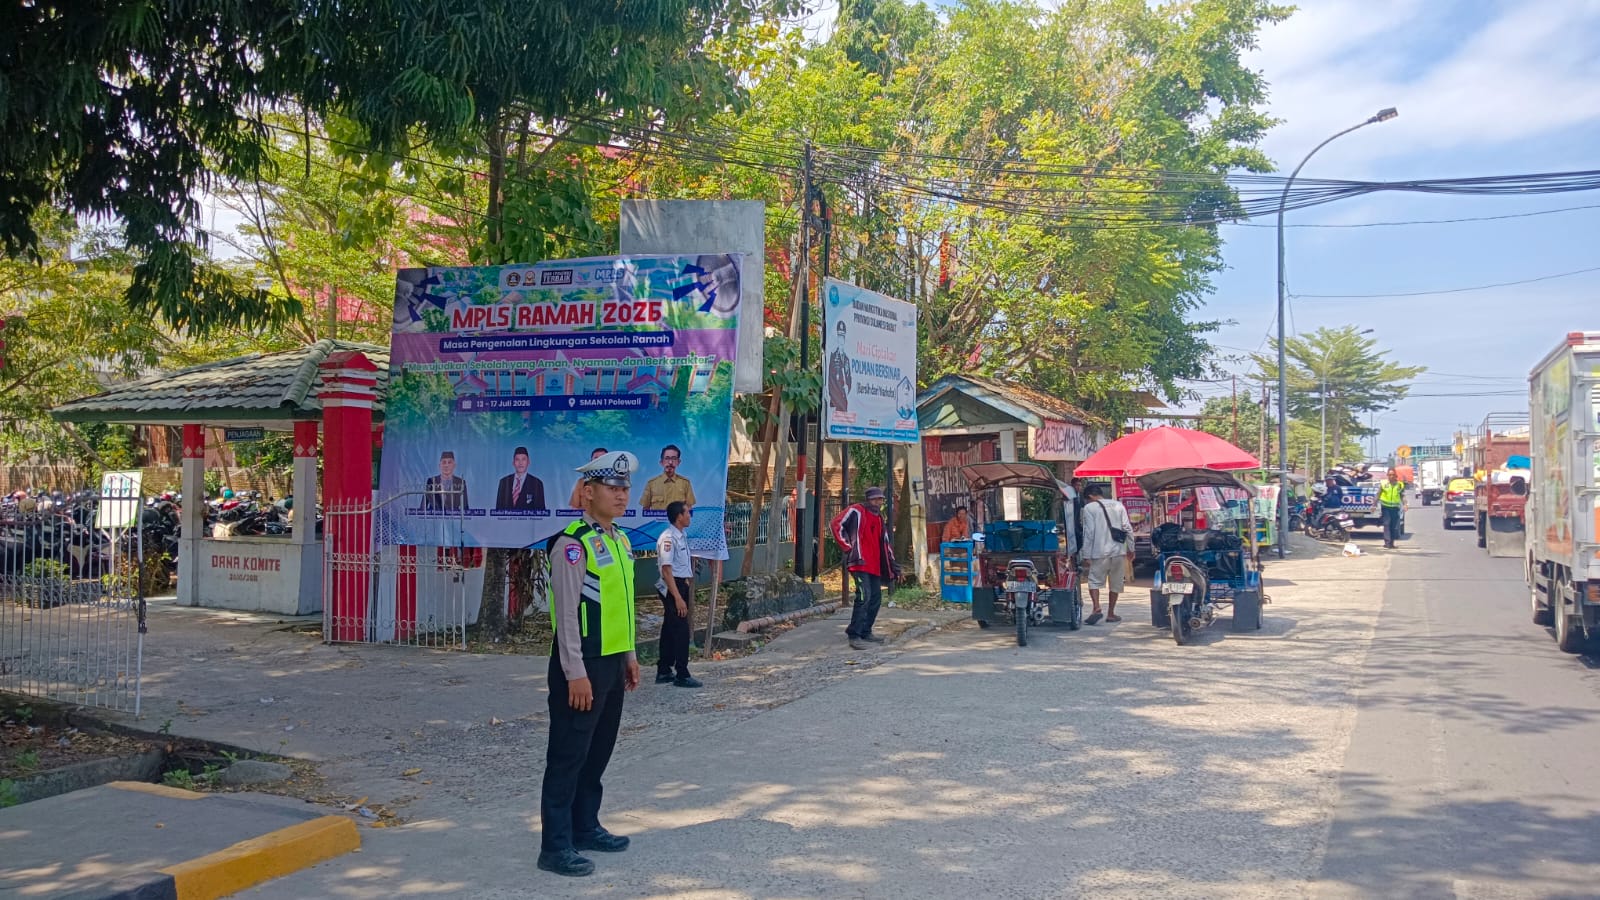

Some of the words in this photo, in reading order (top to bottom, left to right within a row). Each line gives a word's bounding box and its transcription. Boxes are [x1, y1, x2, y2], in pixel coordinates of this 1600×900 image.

[596, 269, 623, 279] MPLS
[452, 306, 510, 328] MPLS
[518, 303, 594, 325] RAMAH
[443, 341, 469, 349] Masa
[470, 338, 528, 350] Pengenalan
[529, 337, 588, 349] Lingkungan
[589, 335, 631, 345] Sekolah
[632, 334, 670, 344] Ramah
[469, 360, 509, 370] Sekolah
[510, 362, 535, 372] yang
[537, 358, 571, 369] Aman,
[622, 357, 644, 366] dan
[851, 359, 875, 376] POLMAN
[608, 397, 641, 405] Polewali
[212, 555, 240, 569] DANA
[243, 557, 281, 571] KOMITE
